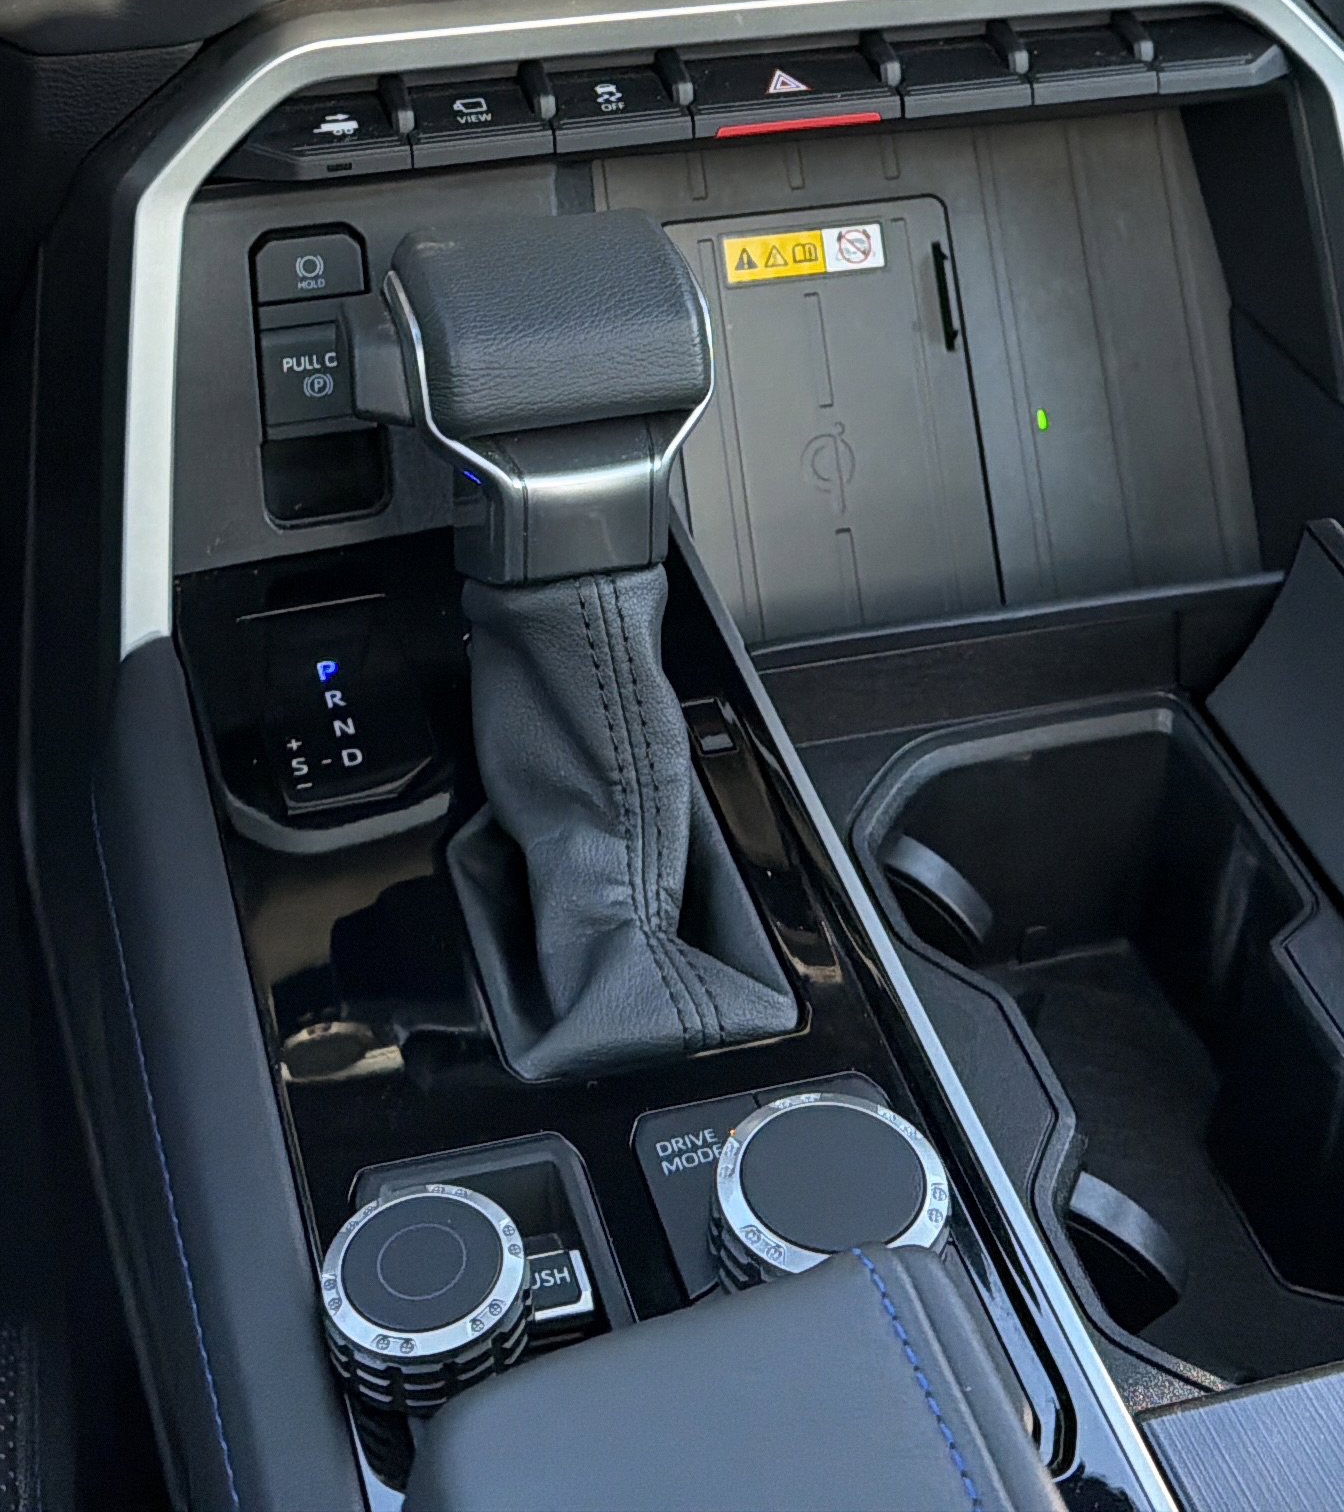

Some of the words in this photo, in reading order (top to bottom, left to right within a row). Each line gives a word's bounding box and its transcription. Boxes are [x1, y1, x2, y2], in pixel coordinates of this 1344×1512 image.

[601, 101, 625, 112] OFF
[457, 113, 492, 124] VIEW
[297, 278, 326, 289] HOLD
[282, 354, 321, 373] PULL
[316, 660, 339, 682] P
[324, 690, 347, 709] R
[332, 717, 356, 738] N
[291, 757, 309, 776] S
[341, 748, 363, 767] D
[656, 1128, 718, 1157] DRIVE
[661, 1143, 723, 1176] MODE
